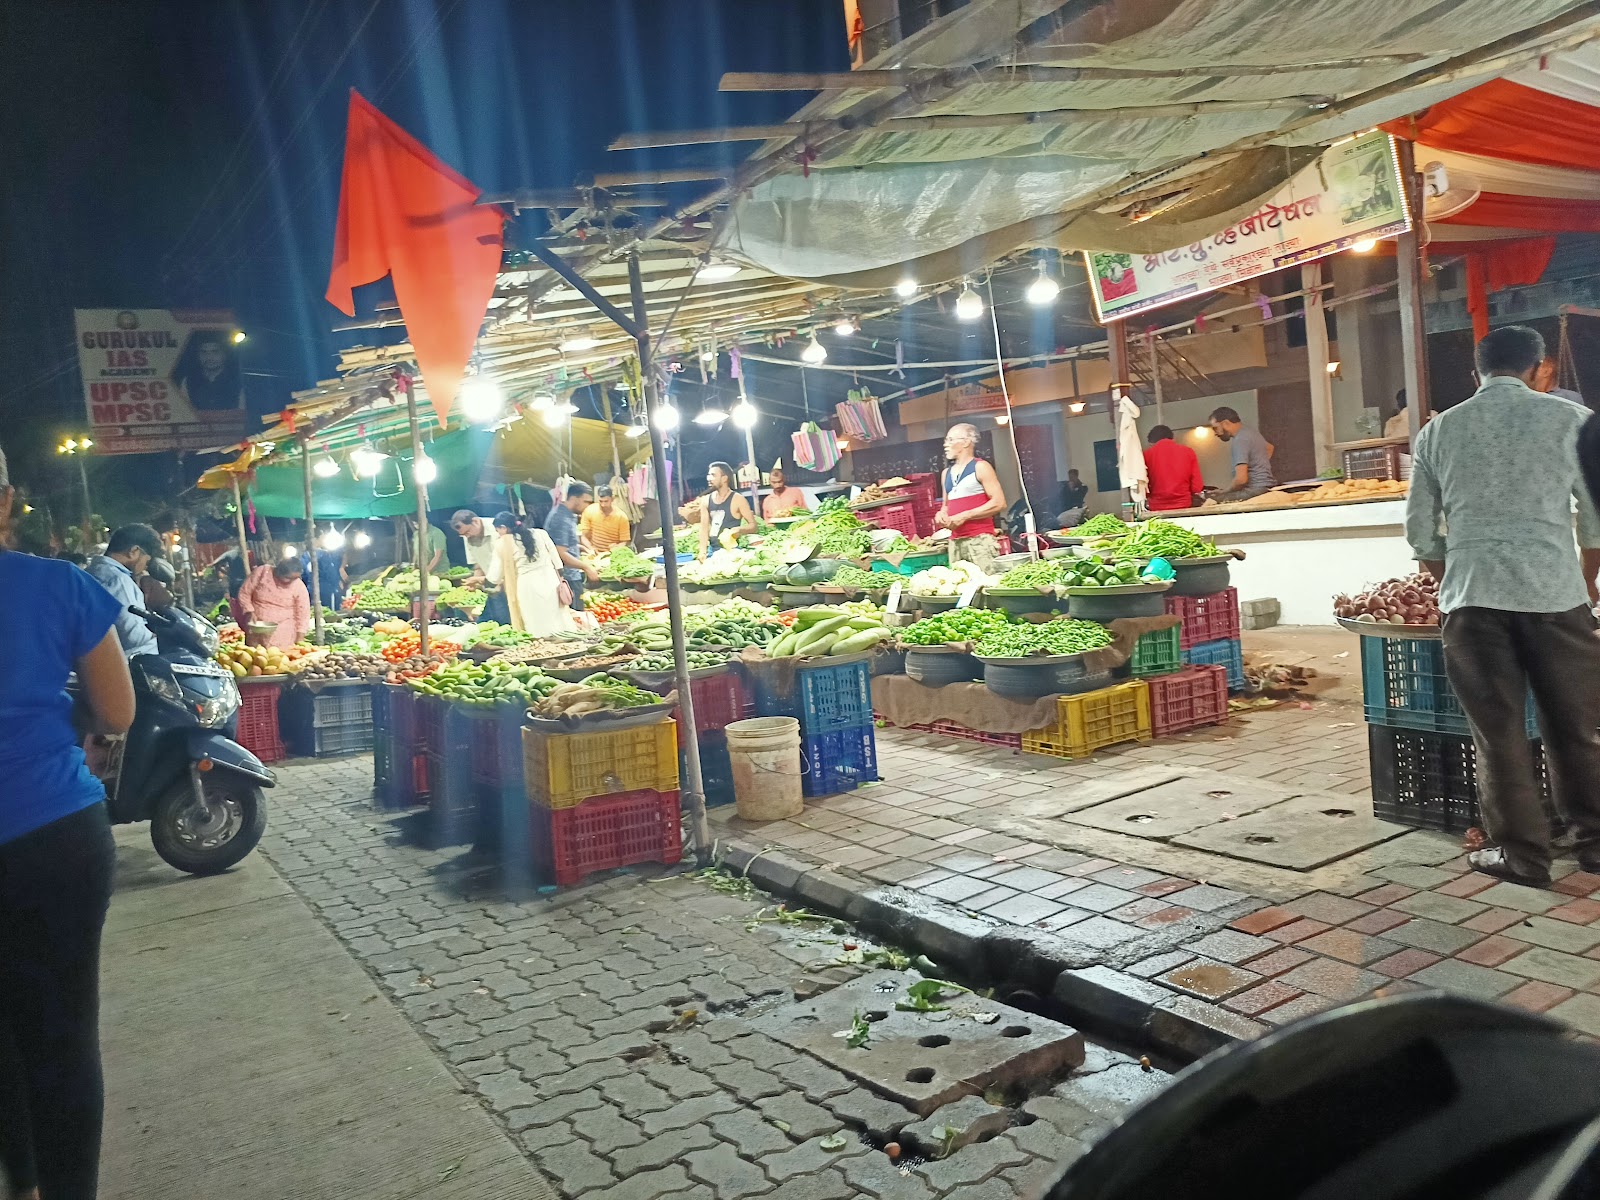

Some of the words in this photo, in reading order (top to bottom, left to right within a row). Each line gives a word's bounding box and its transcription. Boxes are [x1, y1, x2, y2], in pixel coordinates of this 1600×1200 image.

[82, 331, 178, 349] GURUKUL
[106, 350, 149, 367] IAS
[90, 382, 168, 402] UPSC
[92, 403, 171, 423] MPSC
[813, 744, 821, 778] 2021
[863, 735, 872, 768] TSB
